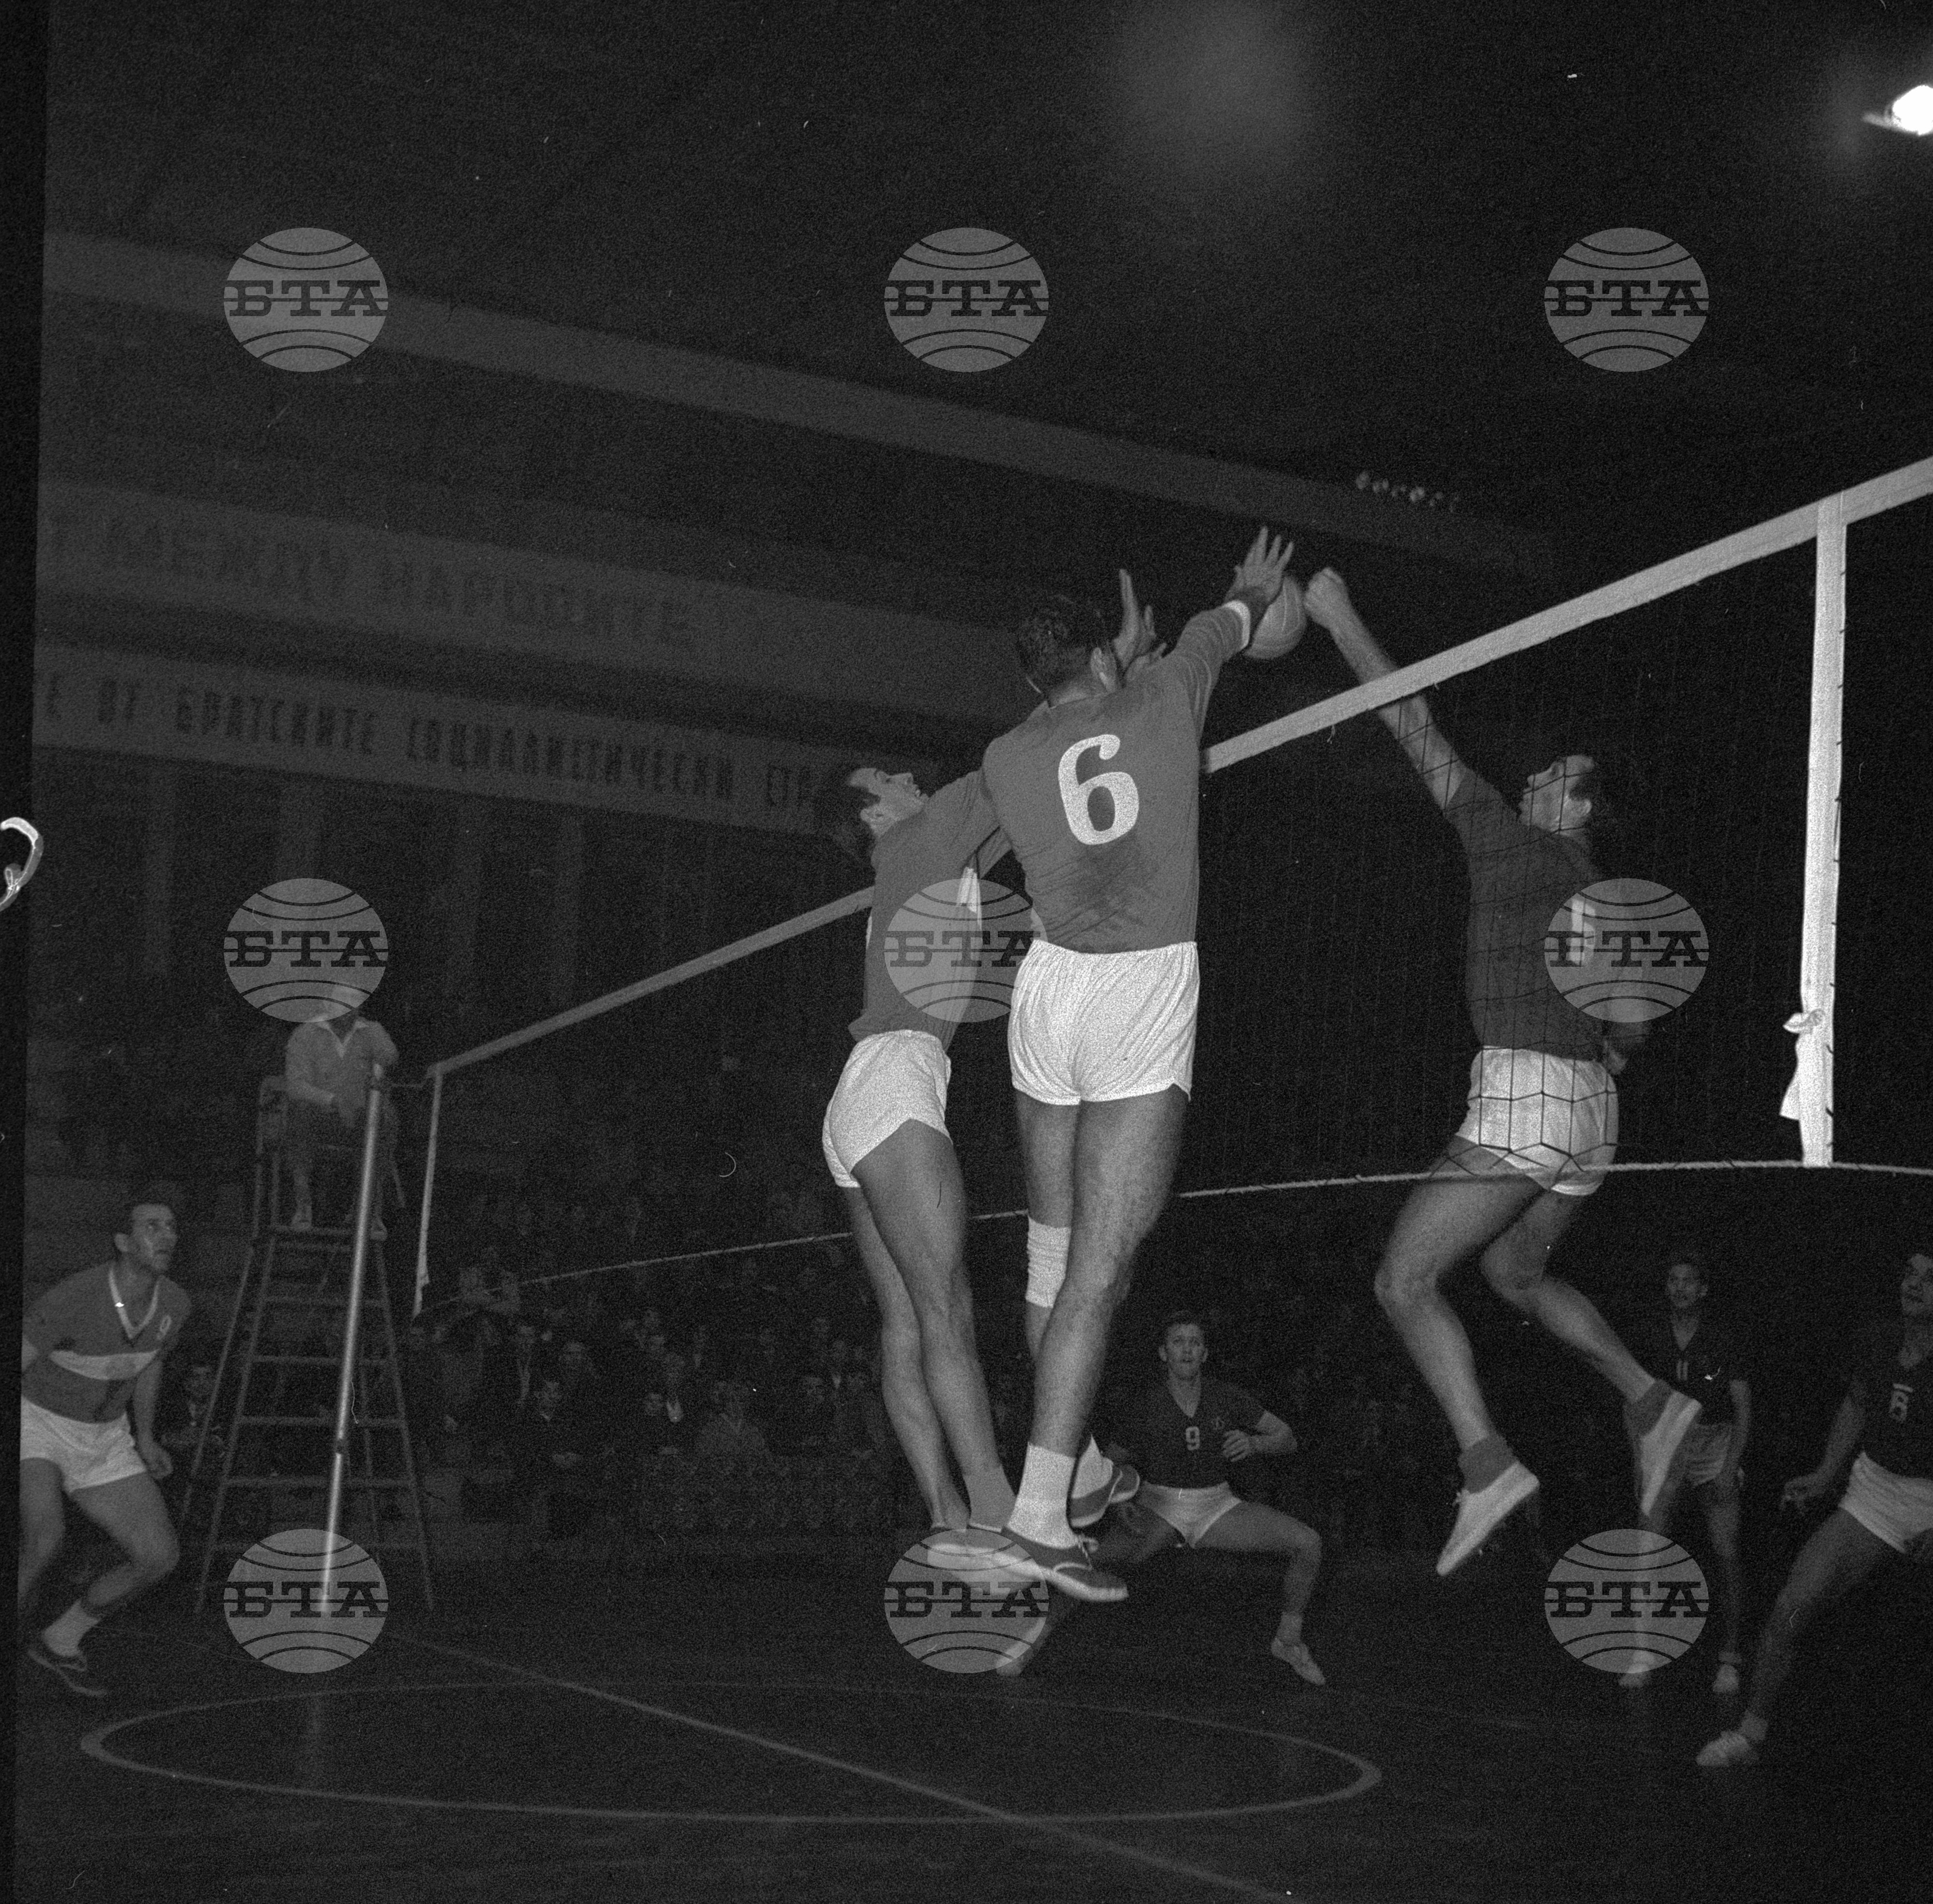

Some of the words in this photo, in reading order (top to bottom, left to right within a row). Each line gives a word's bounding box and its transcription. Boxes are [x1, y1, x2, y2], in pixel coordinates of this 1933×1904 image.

[98, 679, 142, 724] ОТ
[174, 684, 377, 756] БРАТСКИТЕ
[1058, 734, 1140, 845] 6
[1185, 1426, 1200, 1451] 9
